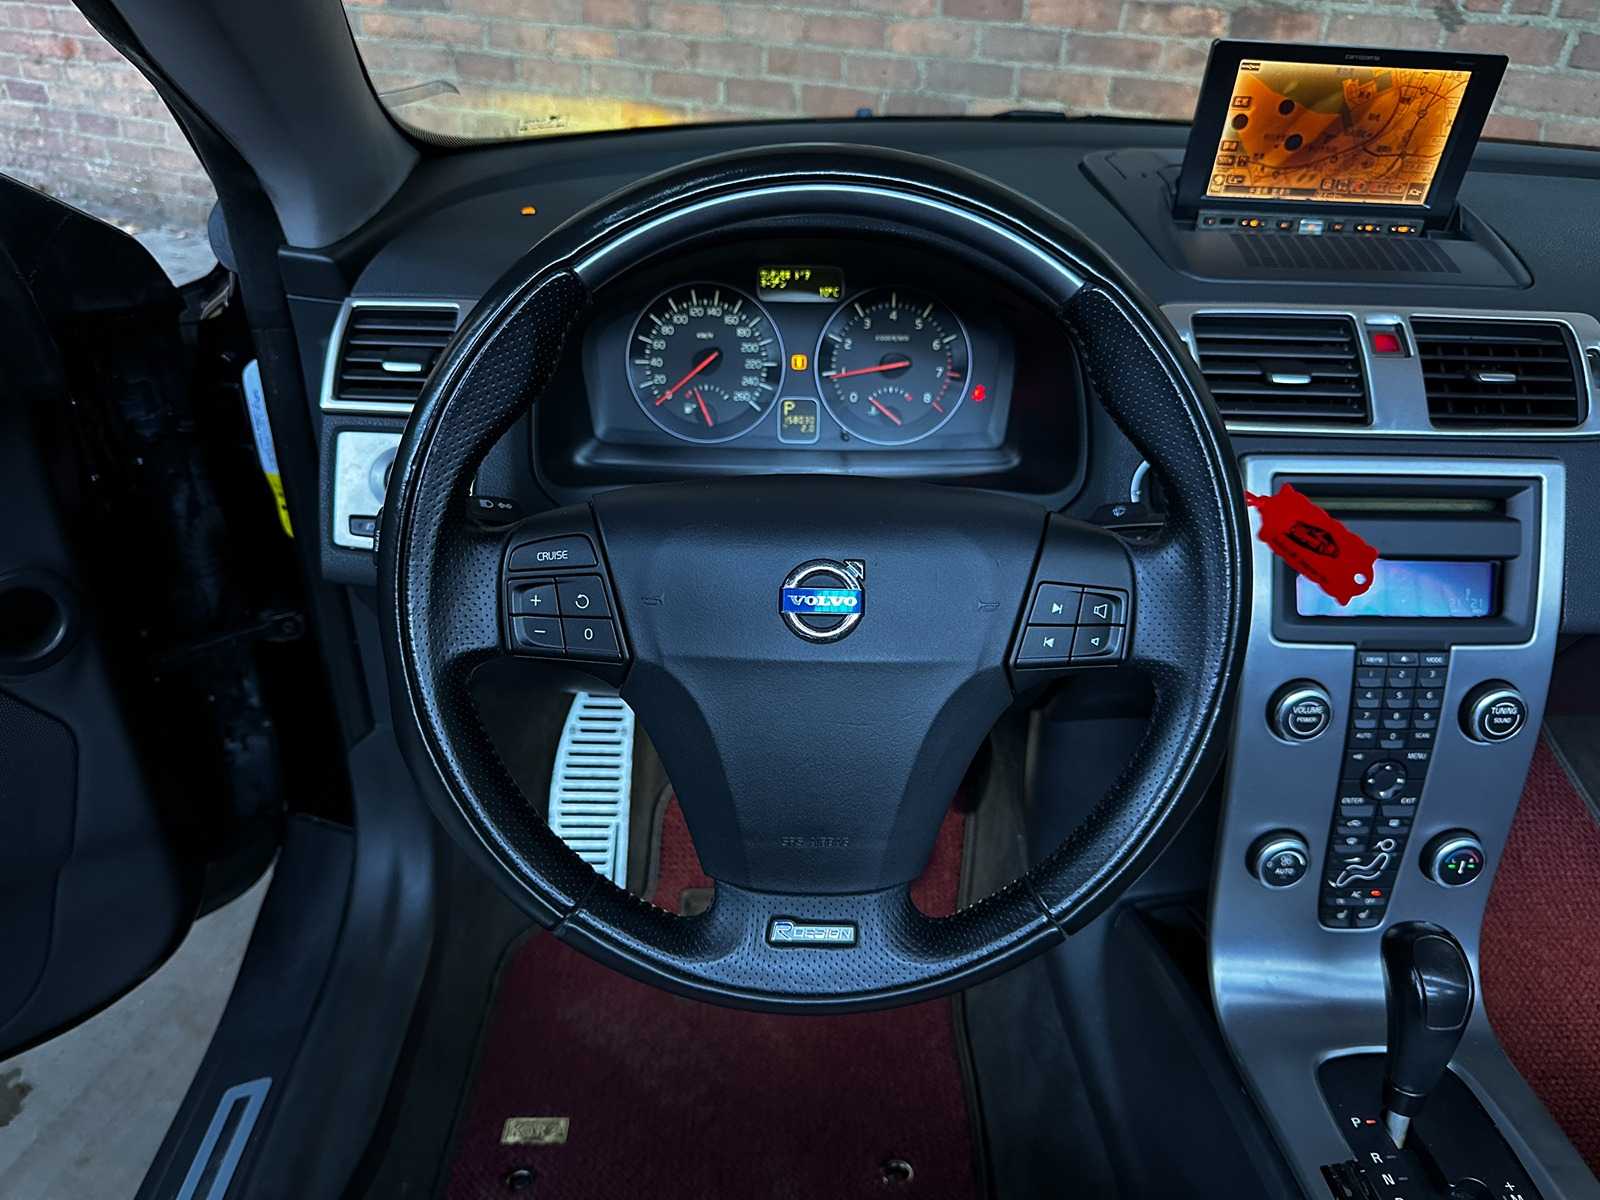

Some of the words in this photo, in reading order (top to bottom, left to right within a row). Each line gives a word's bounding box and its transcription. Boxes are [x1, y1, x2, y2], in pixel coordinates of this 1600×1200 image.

[689, 307, 704, 317] 120
[707, 307, 722, 317] 140
[889, 311, 897, 321] 4
[673, 315, 688, 325] 100
[724, 315, 739, 325] 160
[864, 319, 871, 330] 3
[915, 319, 923, 330] 5
[661, 325, 674, 336] 80
[736, 327, 751, 337] 180
[652, 340, 666, 350] 60
[741, 342, 759, 353] 200
[844, 339, 852, 350] 2
[932, 340, 942, 350] 6
[651, 357, 663, 367] 40
[745, 359, 762, 369] 220
[936, 367, 944, 378] 7
[654, 374, 666, 385] 20
[741, 376, 760, 386] 240
[733, 391, 751, 402] 260
[849, 392, 858, 403] 0
[923, 393, 931, 403] 8
[784, 400, 796, 416] P
[537, 550, 568, 562] CRUISE
[788, 594, 858, 607] VOLVO
[584, 628, 593, 640] 0
[1293, 706, 1324, 714] VOLUME
[1491, 707, 1518, 715] TUNING
[1407, 752, 1427, 760] MENU
[1351, 891, 1362, 899] AC
[1351, 1117, 1361, 1128] P
[1370, 1152, 1383, 1164] R
[1381, 1173, 1395, 1185] N
